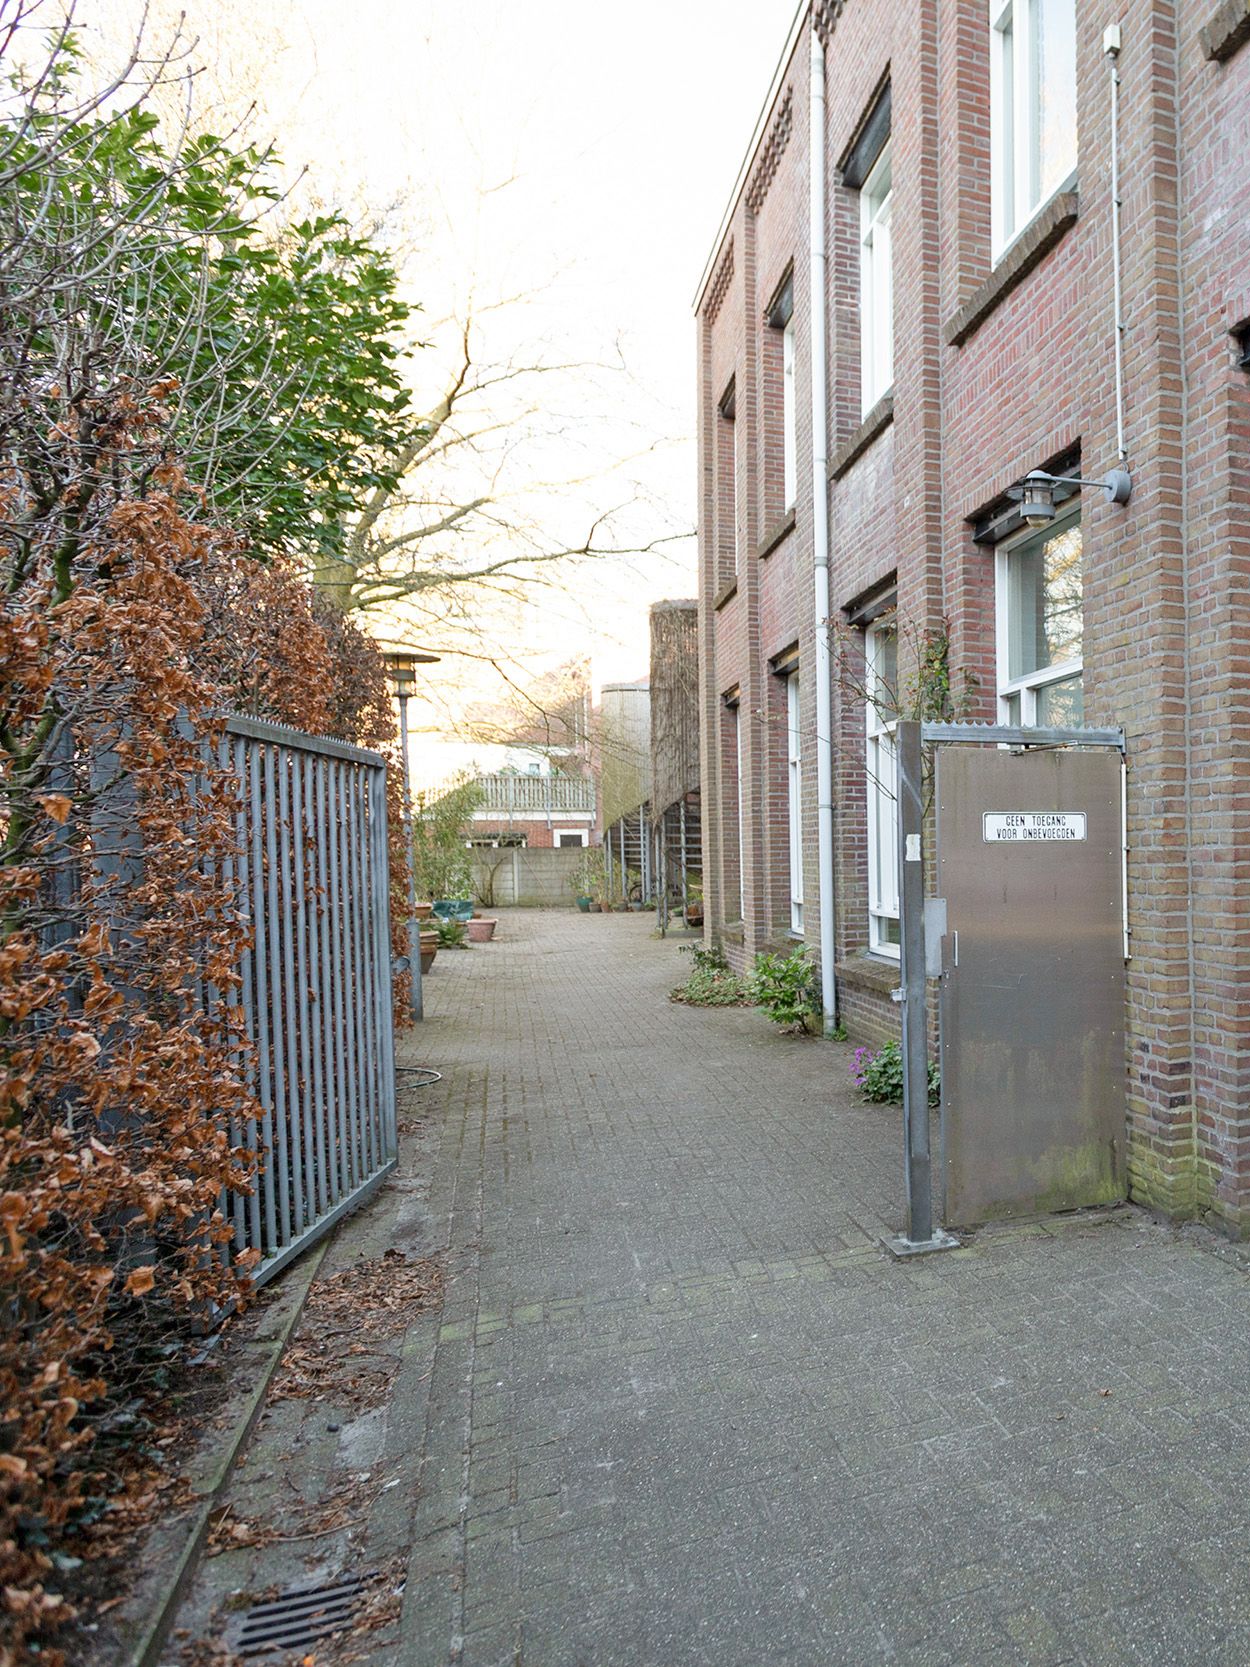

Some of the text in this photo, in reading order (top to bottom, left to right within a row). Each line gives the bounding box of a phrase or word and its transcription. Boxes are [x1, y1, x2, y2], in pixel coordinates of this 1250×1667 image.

[1005, 815, 1066, 826] GEEN TOEGANG
[996, 828, 1076, 839] VOOR ONBEVOEGDEN
